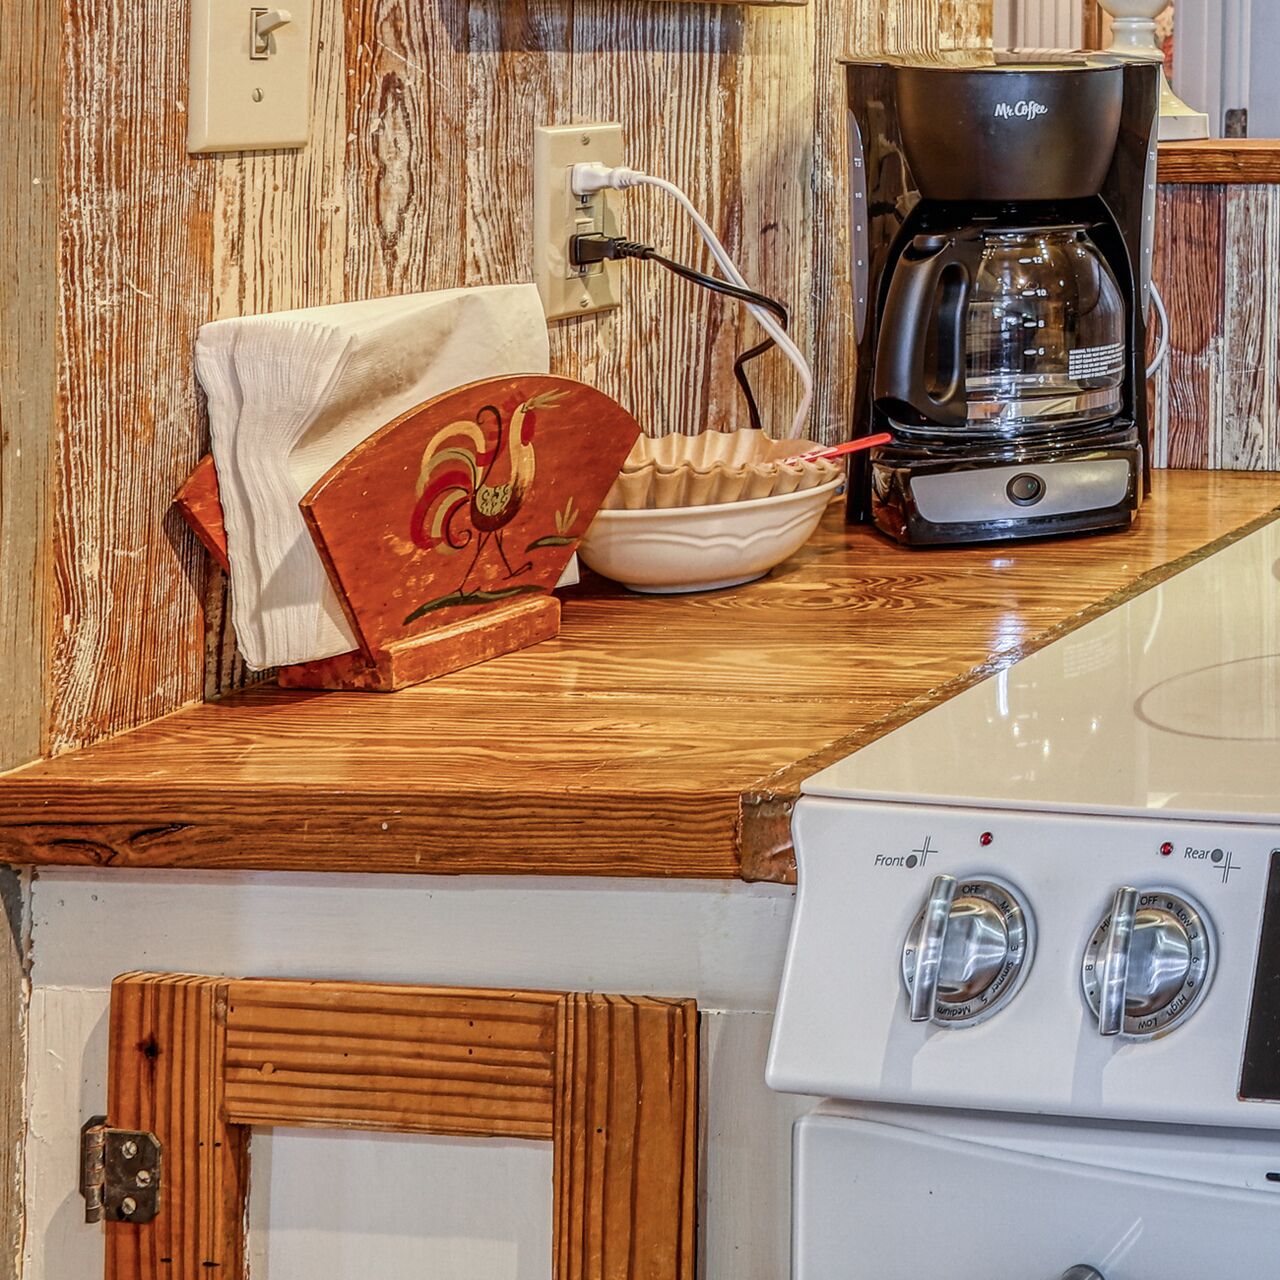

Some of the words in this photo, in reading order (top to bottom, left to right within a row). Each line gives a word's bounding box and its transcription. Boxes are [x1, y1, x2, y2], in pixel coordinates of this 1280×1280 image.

[994, 102, 1014, 120] Mr.
[1014, 100, 1048, 121] Coffee
[1032, 256, 1043, 264] 12
[1036, 288, 1047, 297] 10
[1184, 846, 1210, 860] Rear
[874, 854, 905, 867] Front
[962, 885, 980, 895] OFF
[1140, 895, 1159, 906] OFF
[1175, 909, 1193, 927] Low
[1189, 932, 1198, 940] 3
